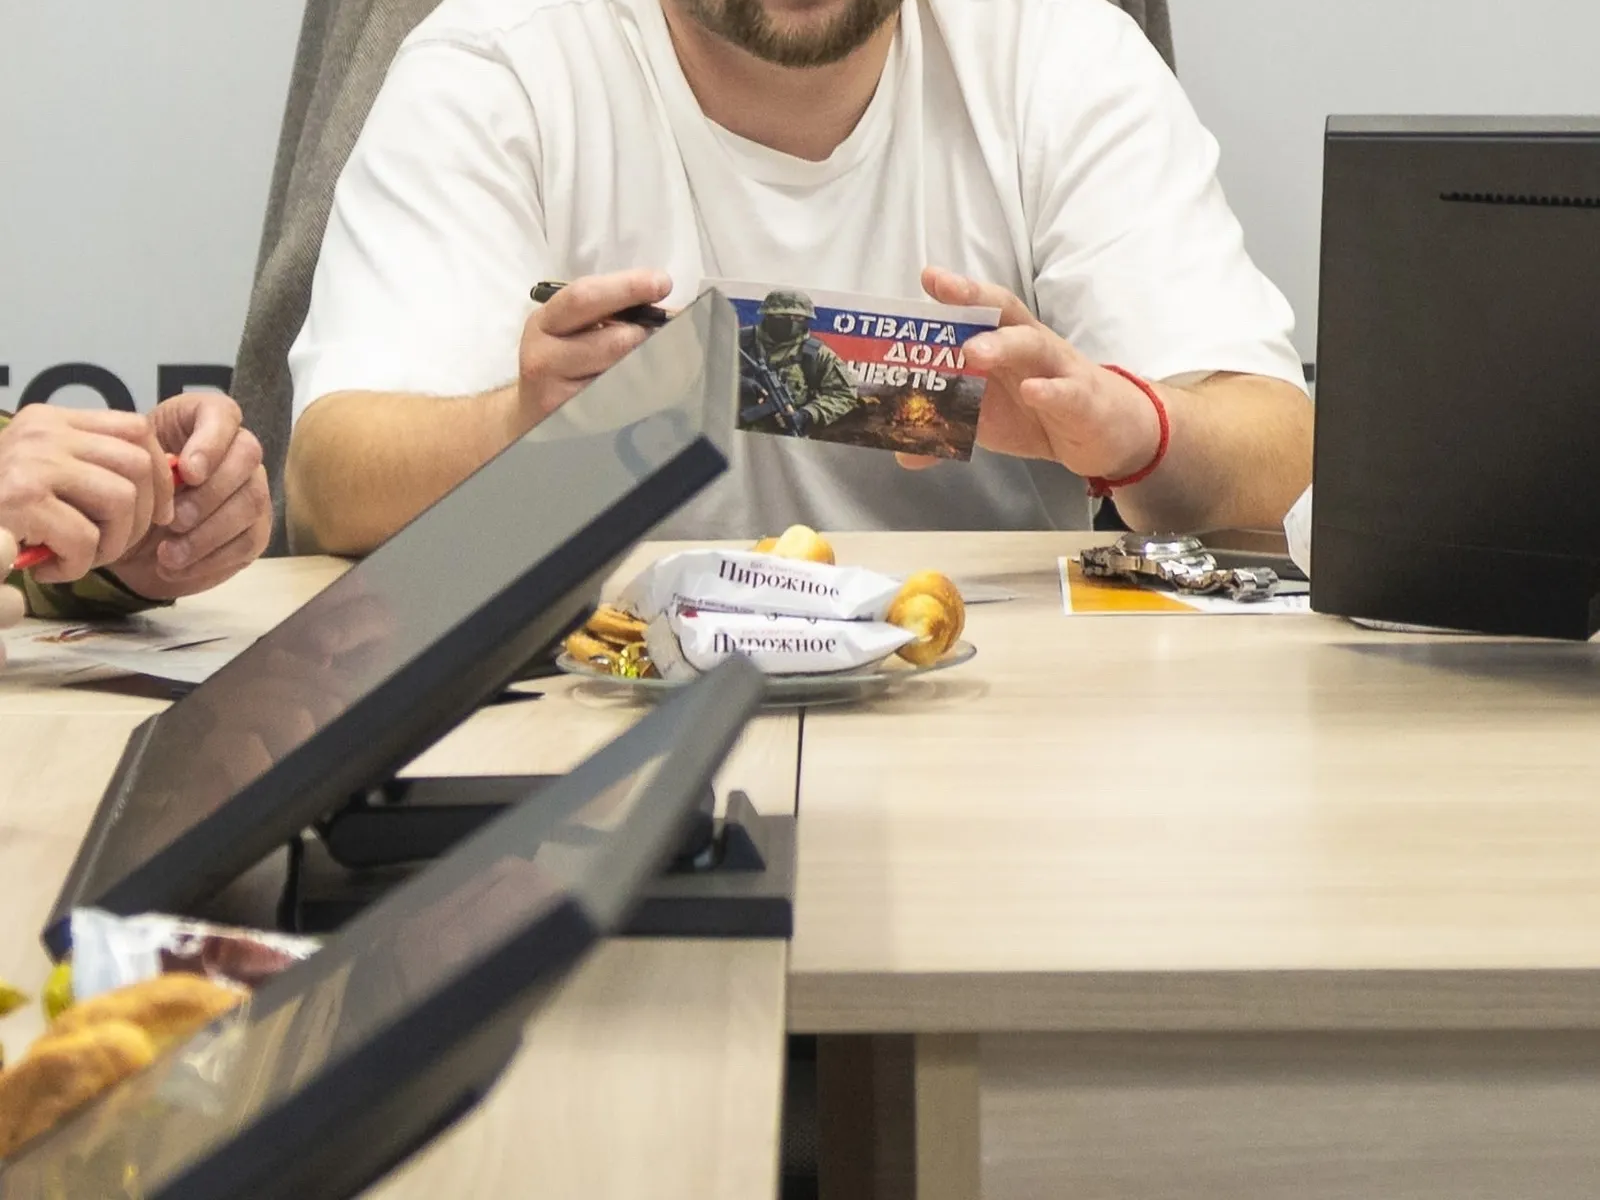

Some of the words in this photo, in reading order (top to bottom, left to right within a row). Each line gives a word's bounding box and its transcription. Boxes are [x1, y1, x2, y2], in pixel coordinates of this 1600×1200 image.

[833, 313, 957, 346] ОТВАГА
[847, 359, 947, 392] ЧЕСТЬ
[718, 559, 840, 599] Пирожное
